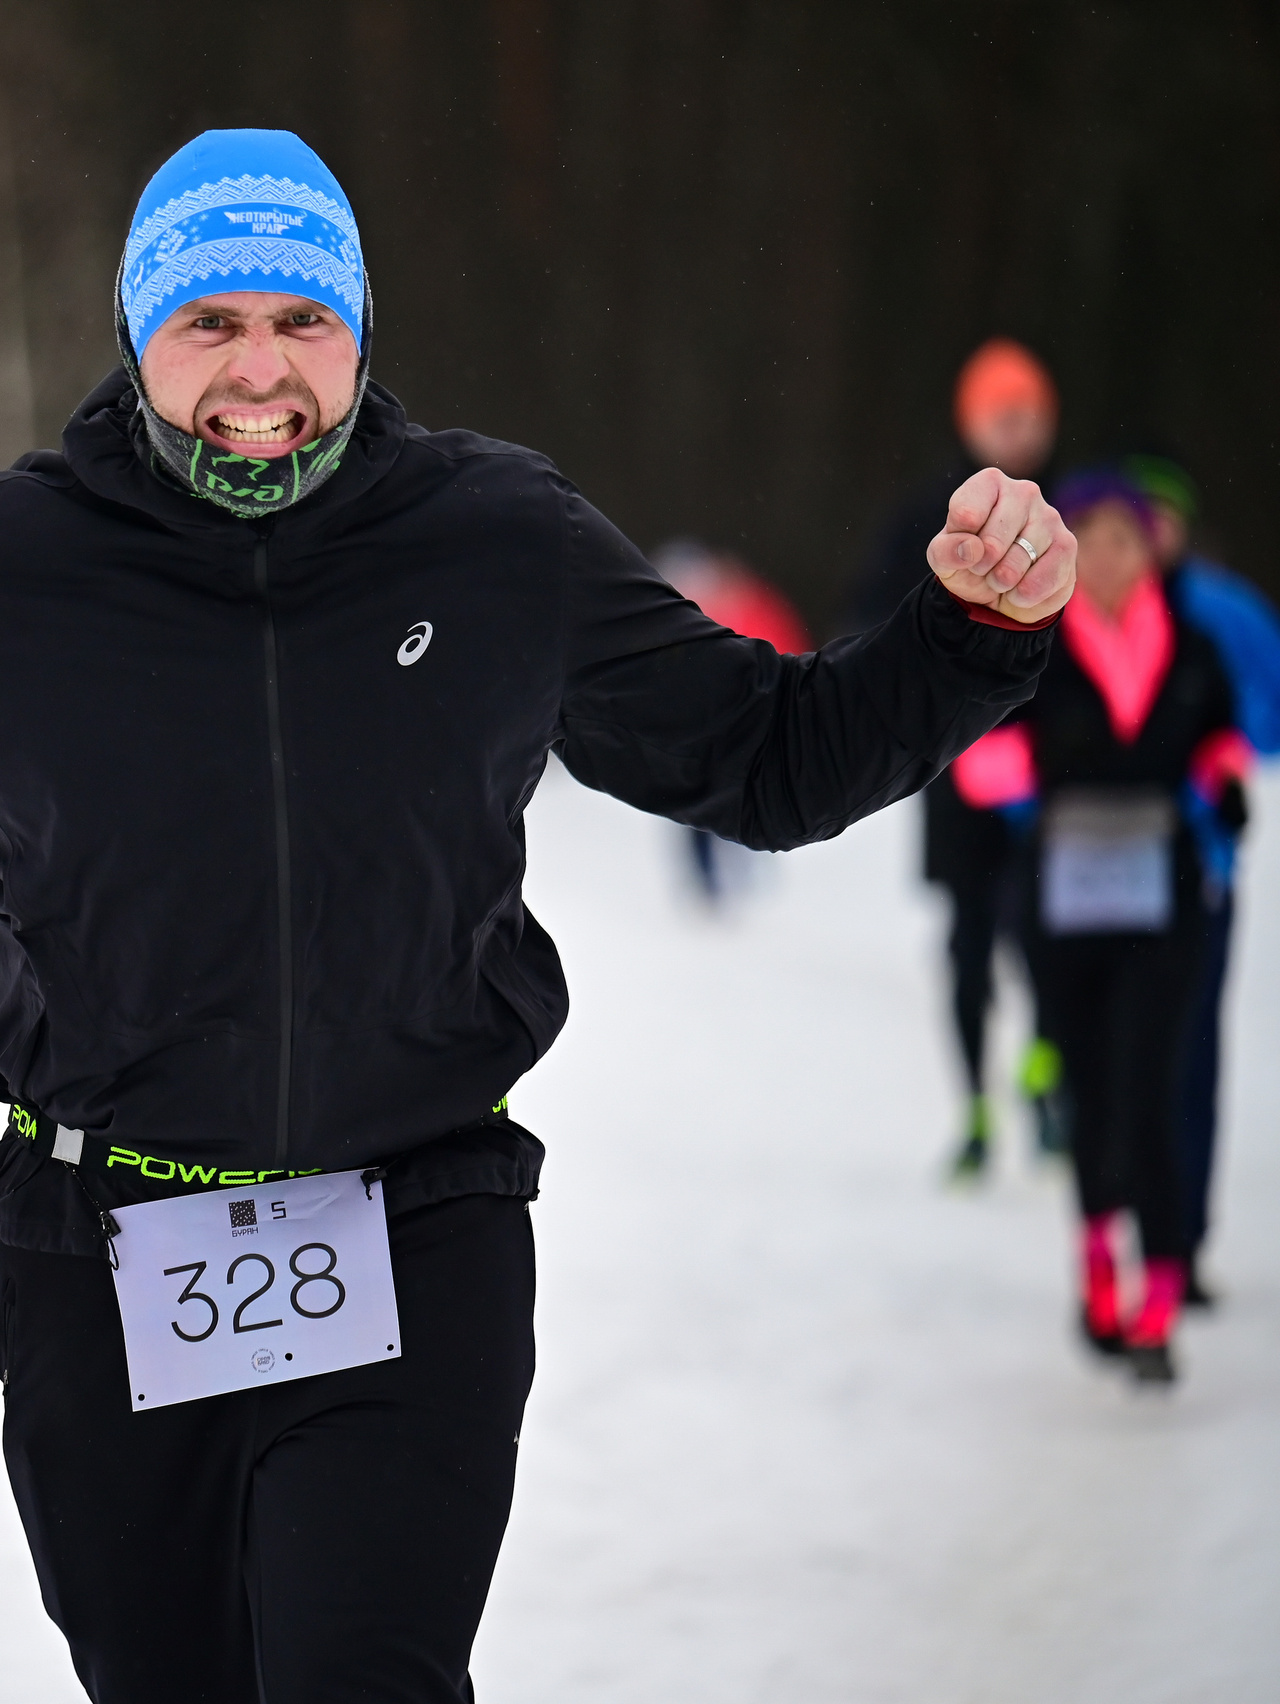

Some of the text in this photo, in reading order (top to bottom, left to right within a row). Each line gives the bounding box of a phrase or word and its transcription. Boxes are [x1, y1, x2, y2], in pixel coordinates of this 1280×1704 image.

[232, 211, 304, 227] НЕОТКРЫТЫЕ
[231, 1227, 259, 1238] БУРАН
[163, 1242, 346, 1342] 328
